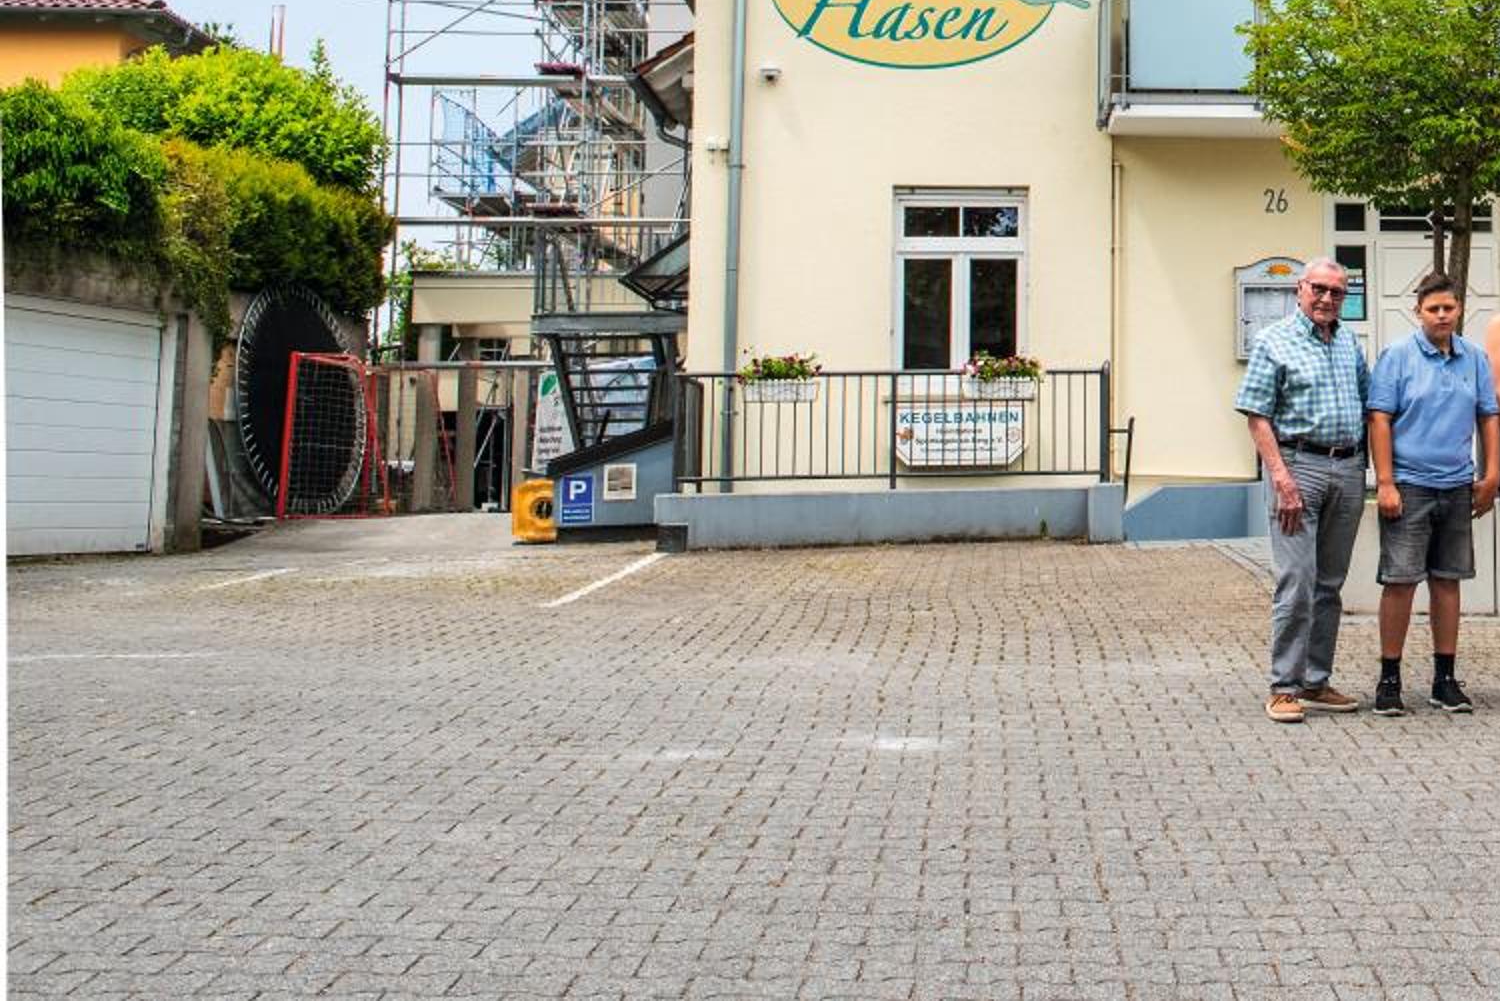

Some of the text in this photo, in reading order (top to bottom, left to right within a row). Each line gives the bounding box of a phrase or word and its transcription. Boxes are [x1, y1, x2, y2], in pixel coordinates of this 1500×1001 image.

[1264, 188, 1289, 213] 26
[899, 411, 1020, 424] KEGELBAHNEN
[569, 480, 587, 501] P
